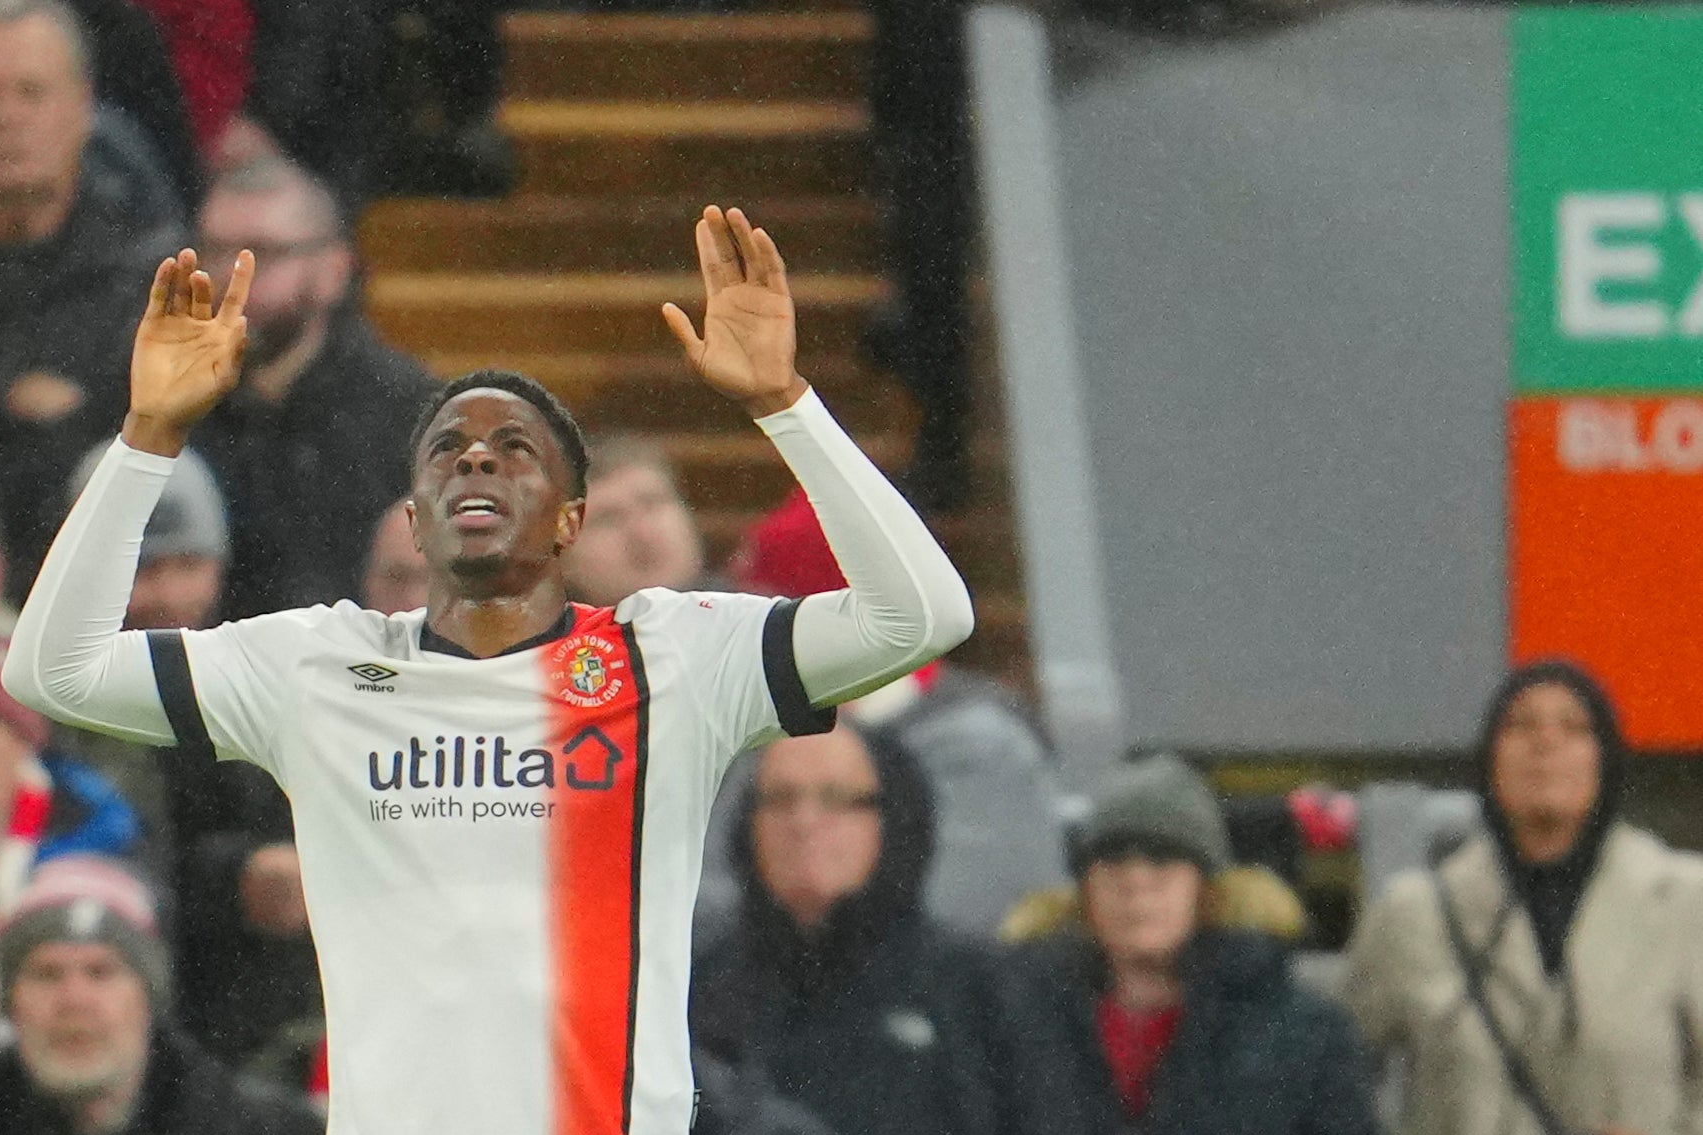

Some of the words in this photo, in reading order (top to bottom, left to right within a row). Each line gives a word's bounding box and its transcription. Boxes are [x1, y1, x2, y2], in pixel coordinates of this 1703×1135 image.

[1557, 194, 1703, 339] E
[552, 636, 582, 662] LUTON
[583, 634, 615, 654] TOWN
[354, 682, 395, 693] umbro
[560, 688, 605, 708] FOOTBALL
[602, 678, 623, 701] CLUB
[369, 735, 555, 791] utilita
[369, 799, 403, 821] life
[411, 795, 463, 819] with
[472, 801, 556, 823] power
